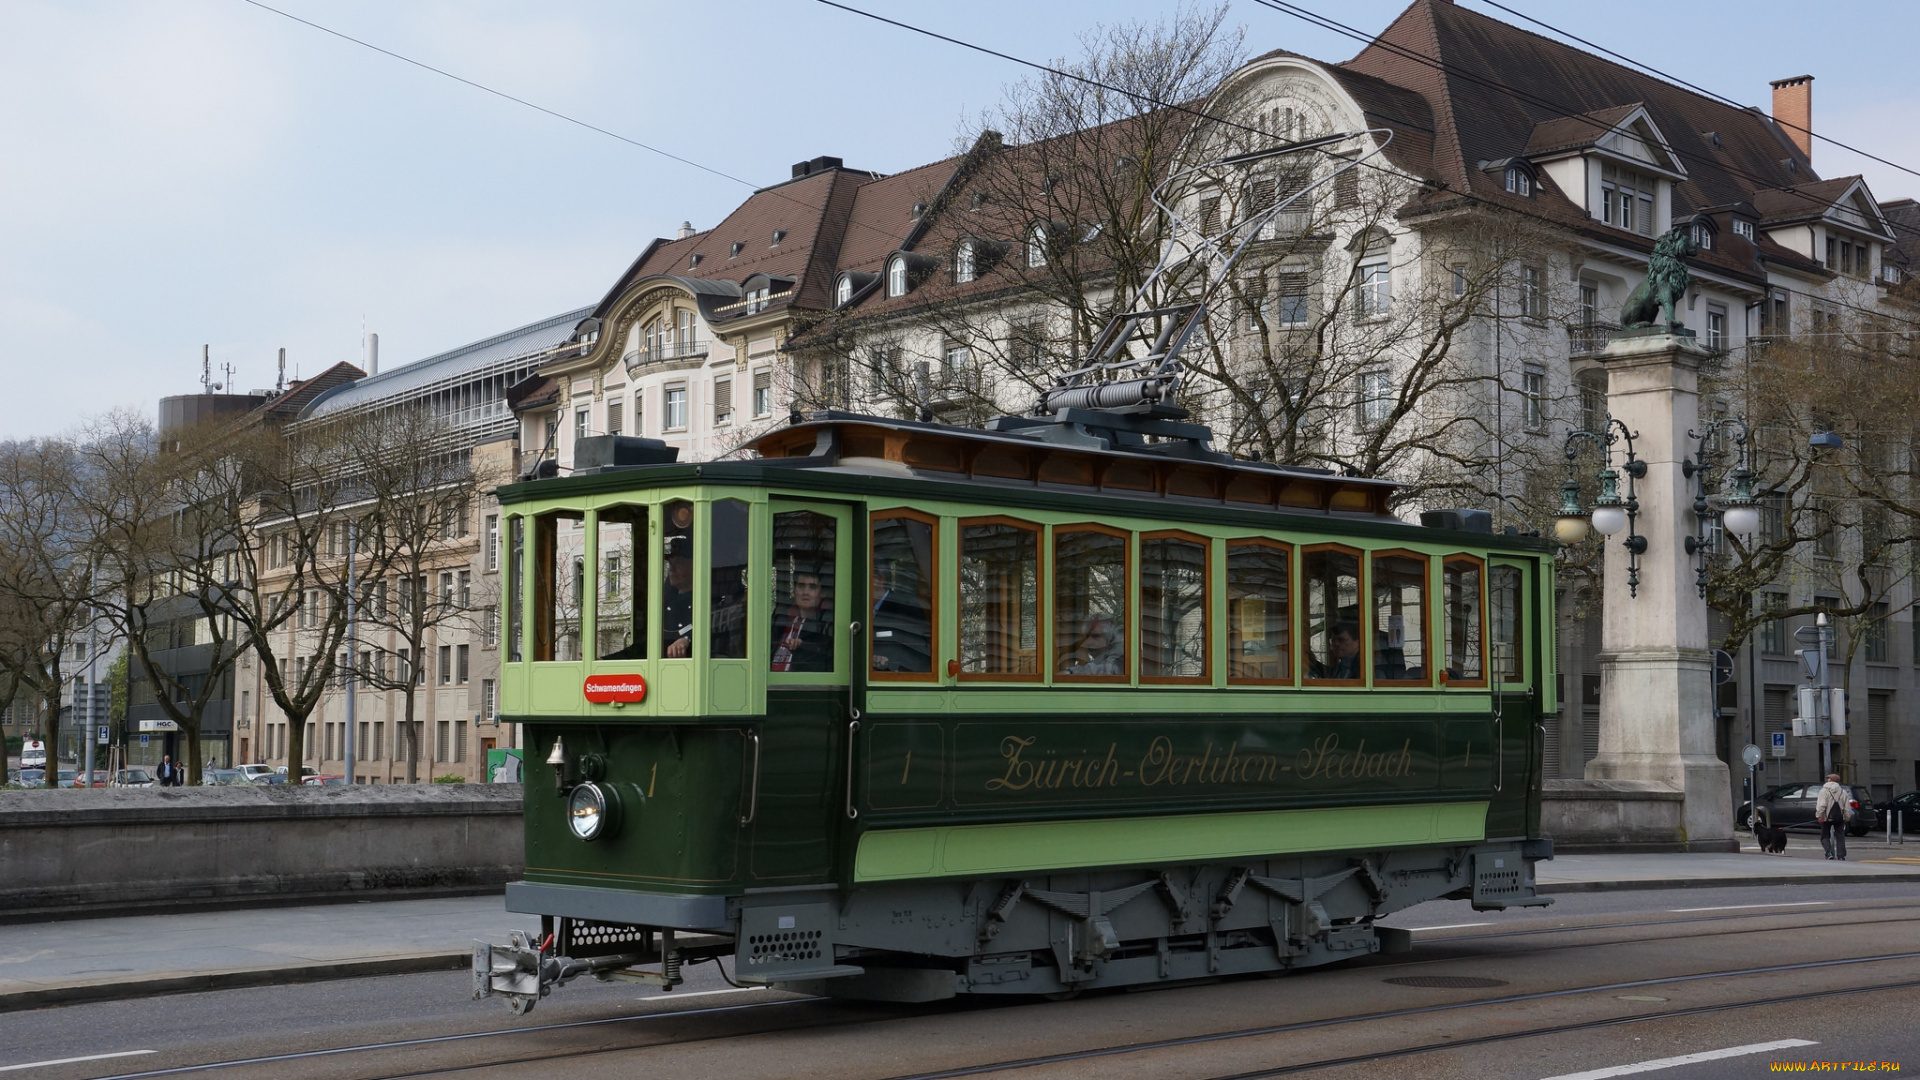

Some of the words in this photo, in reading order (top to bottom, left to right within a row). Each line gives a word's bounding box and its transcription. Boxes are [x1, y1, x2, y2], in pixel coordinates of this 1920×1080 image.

[586, 683, 642, 693] Schwamendingen
[901, 750, 911, 784] 1
[1463, 739, 1471, 767] 1
[647, 762, 657, 797] 1
